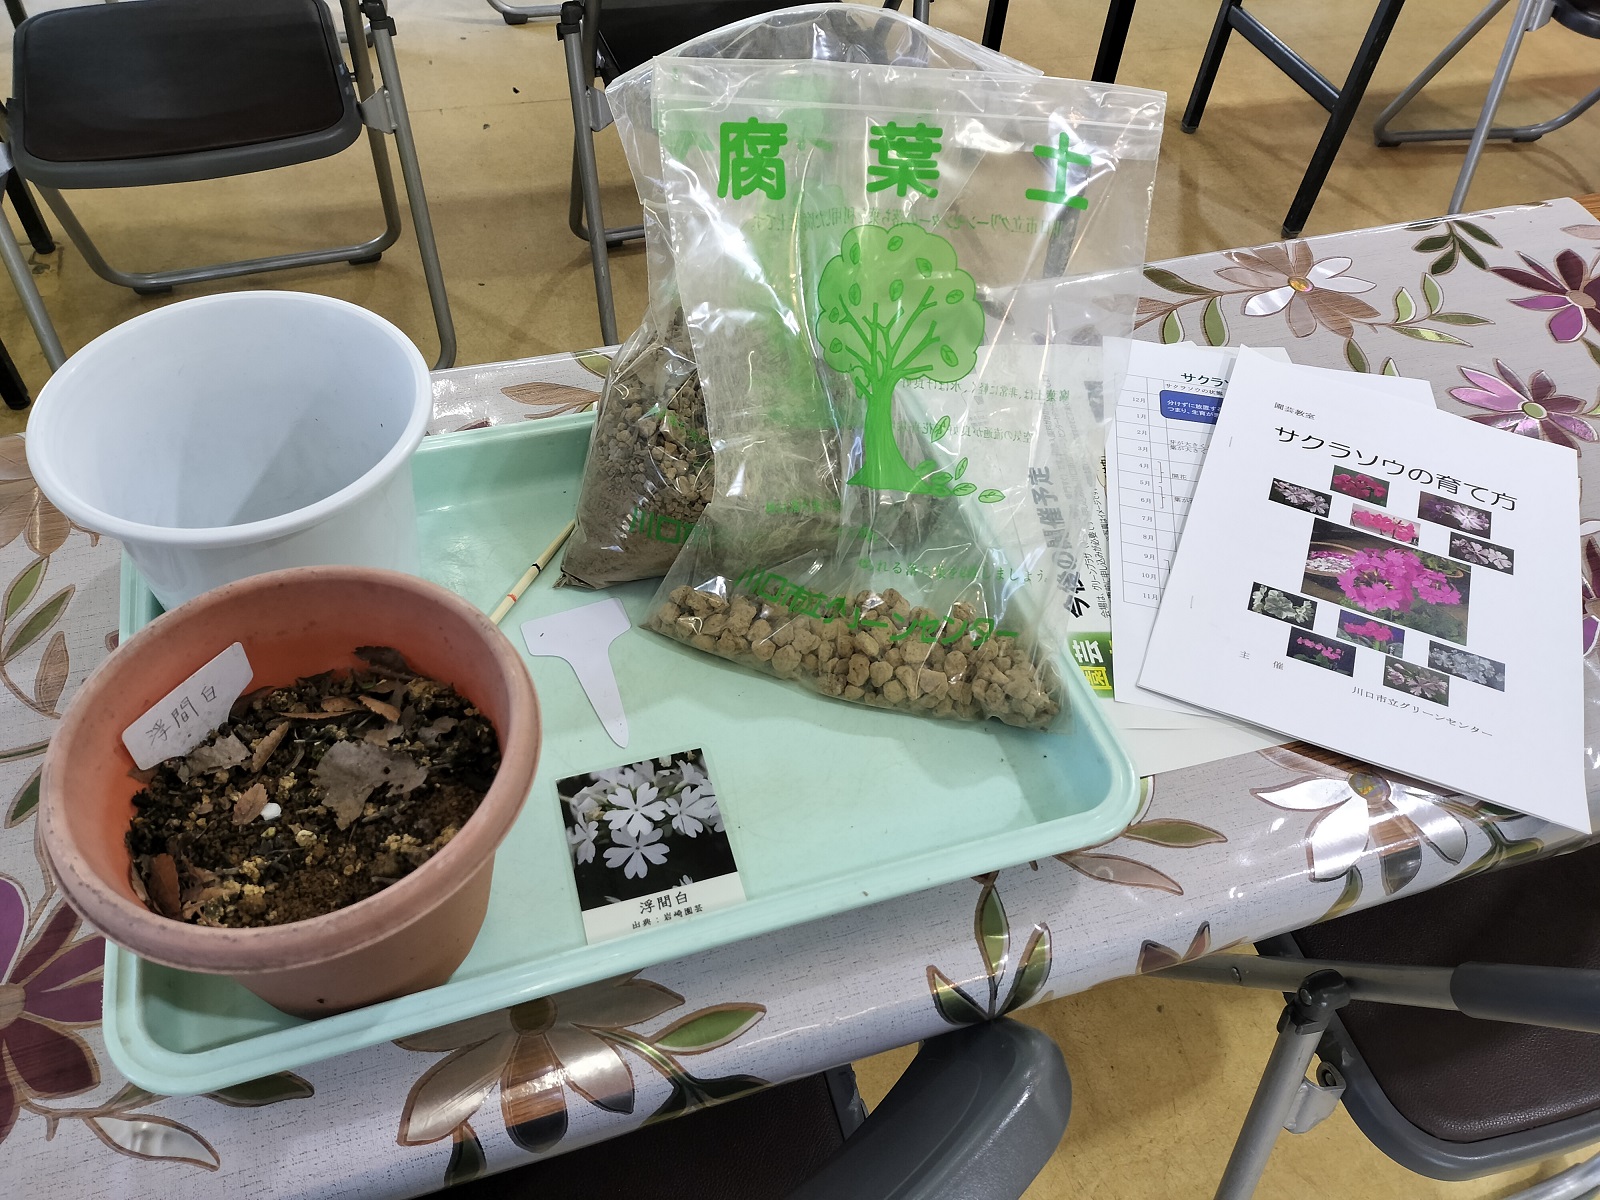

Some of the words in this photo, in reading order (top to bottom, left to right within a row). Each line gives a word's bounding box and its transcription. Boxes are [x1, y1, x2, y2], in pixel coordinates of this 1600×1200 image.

[717, 117, 1091, 210] 腐葉土
[1181, 373, 1229, 387] サクラ
[1274, 402, 1316, 420] 園芸教室
[1275, 427, 1518, 511] サクラソウの育て方
[1028, 466, 1090, 618] 今後の開催予定
[1141, 572, 1156, 580] 10月
[732, 568, 1021, 647] 川口市立グリーンセンター
[1142, 592, 1158, 601] 11月
[1351, 685, 1493, 737] 川口市立グリーンセンター
[639, 891, 689, 914] 浮間白
